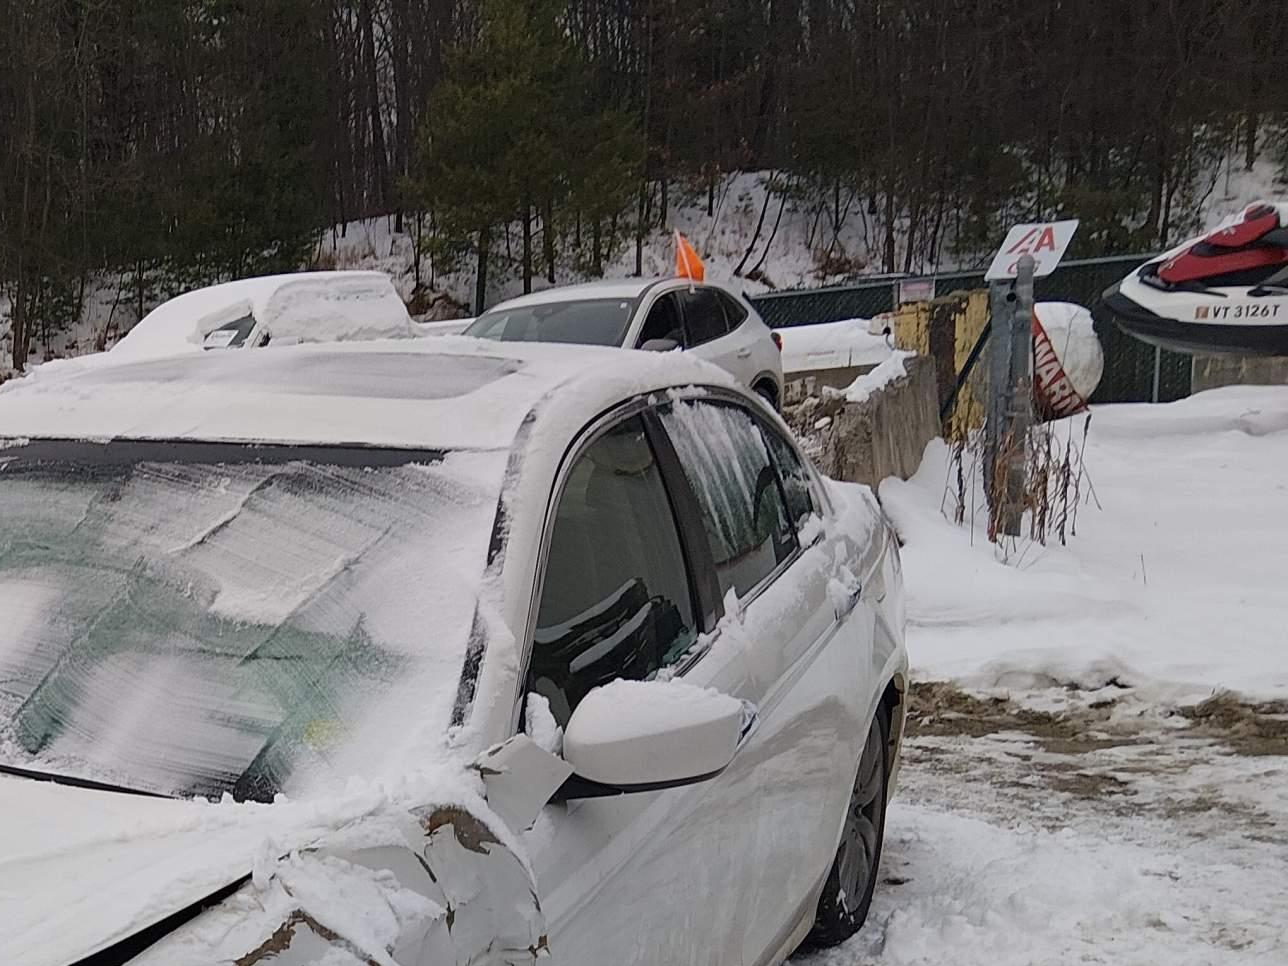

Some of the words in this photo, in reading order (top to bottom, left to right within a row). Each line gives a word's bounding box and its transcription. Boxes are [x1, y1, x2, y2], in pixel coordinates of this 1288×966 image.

[1213, 306, 1231, 319] VT
[1234, 304, 1269, 319] 3126
[1273, 304, 1280, 317] T
